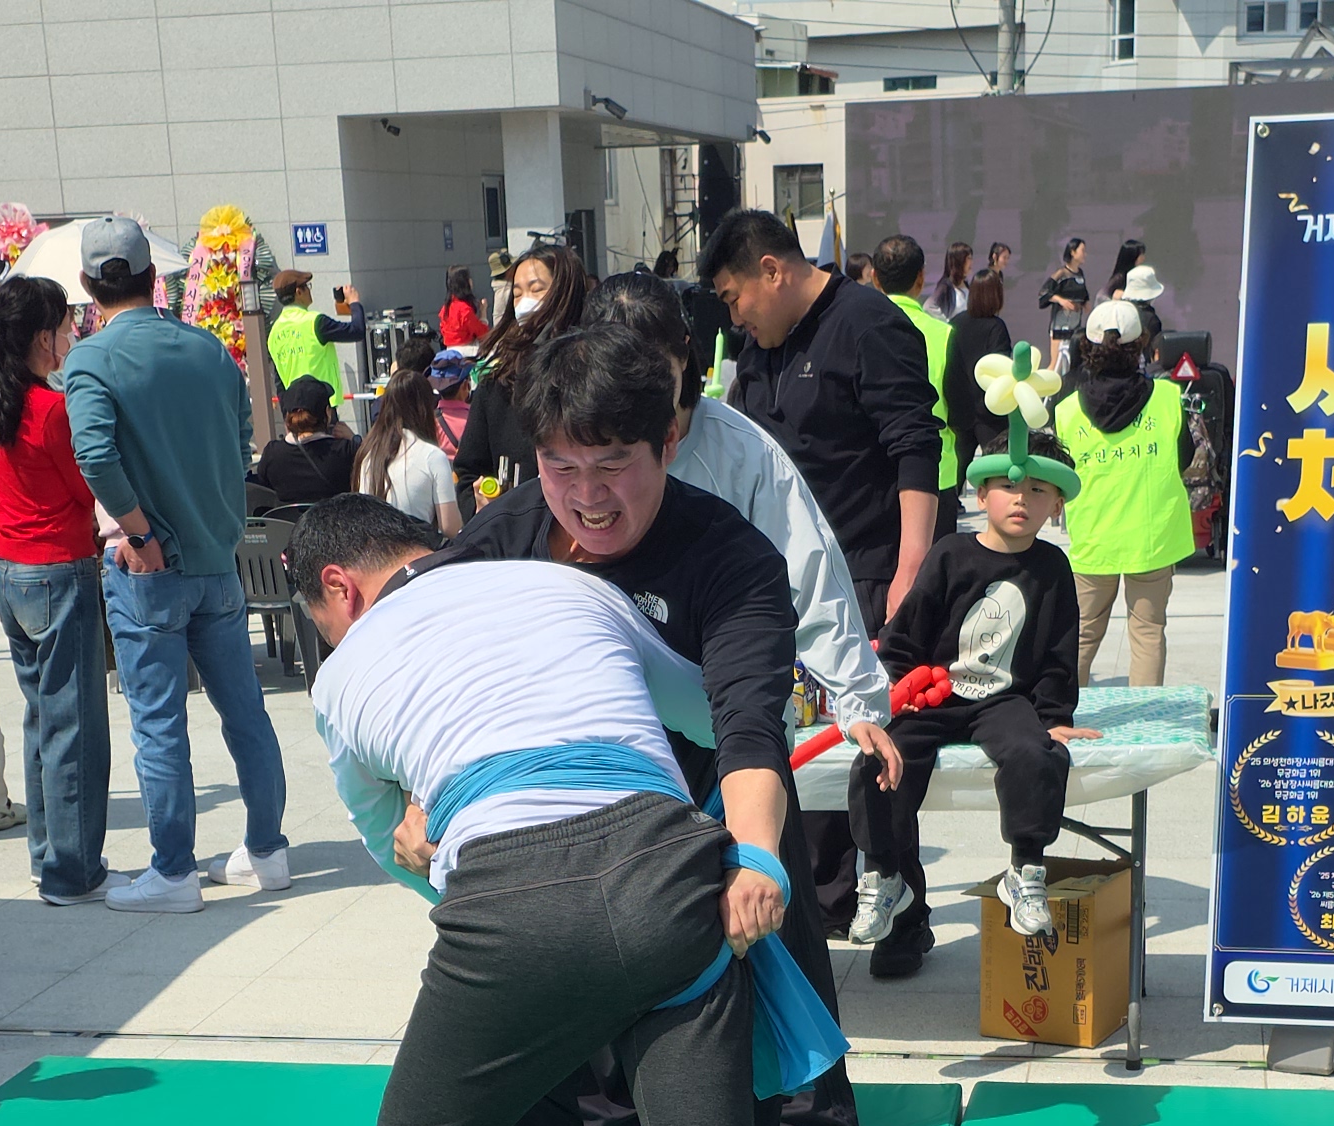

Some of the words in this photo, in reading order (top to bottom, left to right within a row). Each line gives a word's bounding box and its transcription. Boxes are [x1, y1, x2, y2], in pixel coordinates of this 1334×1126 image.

[1079, 441, 1158, 464] 주민자치회
[632, 592, 658, 611] NORTH
[644, 590, 659, 603] THE
[636, 602, 655, 616] FACE
[1285, 977, 1334, 995] 거제시
